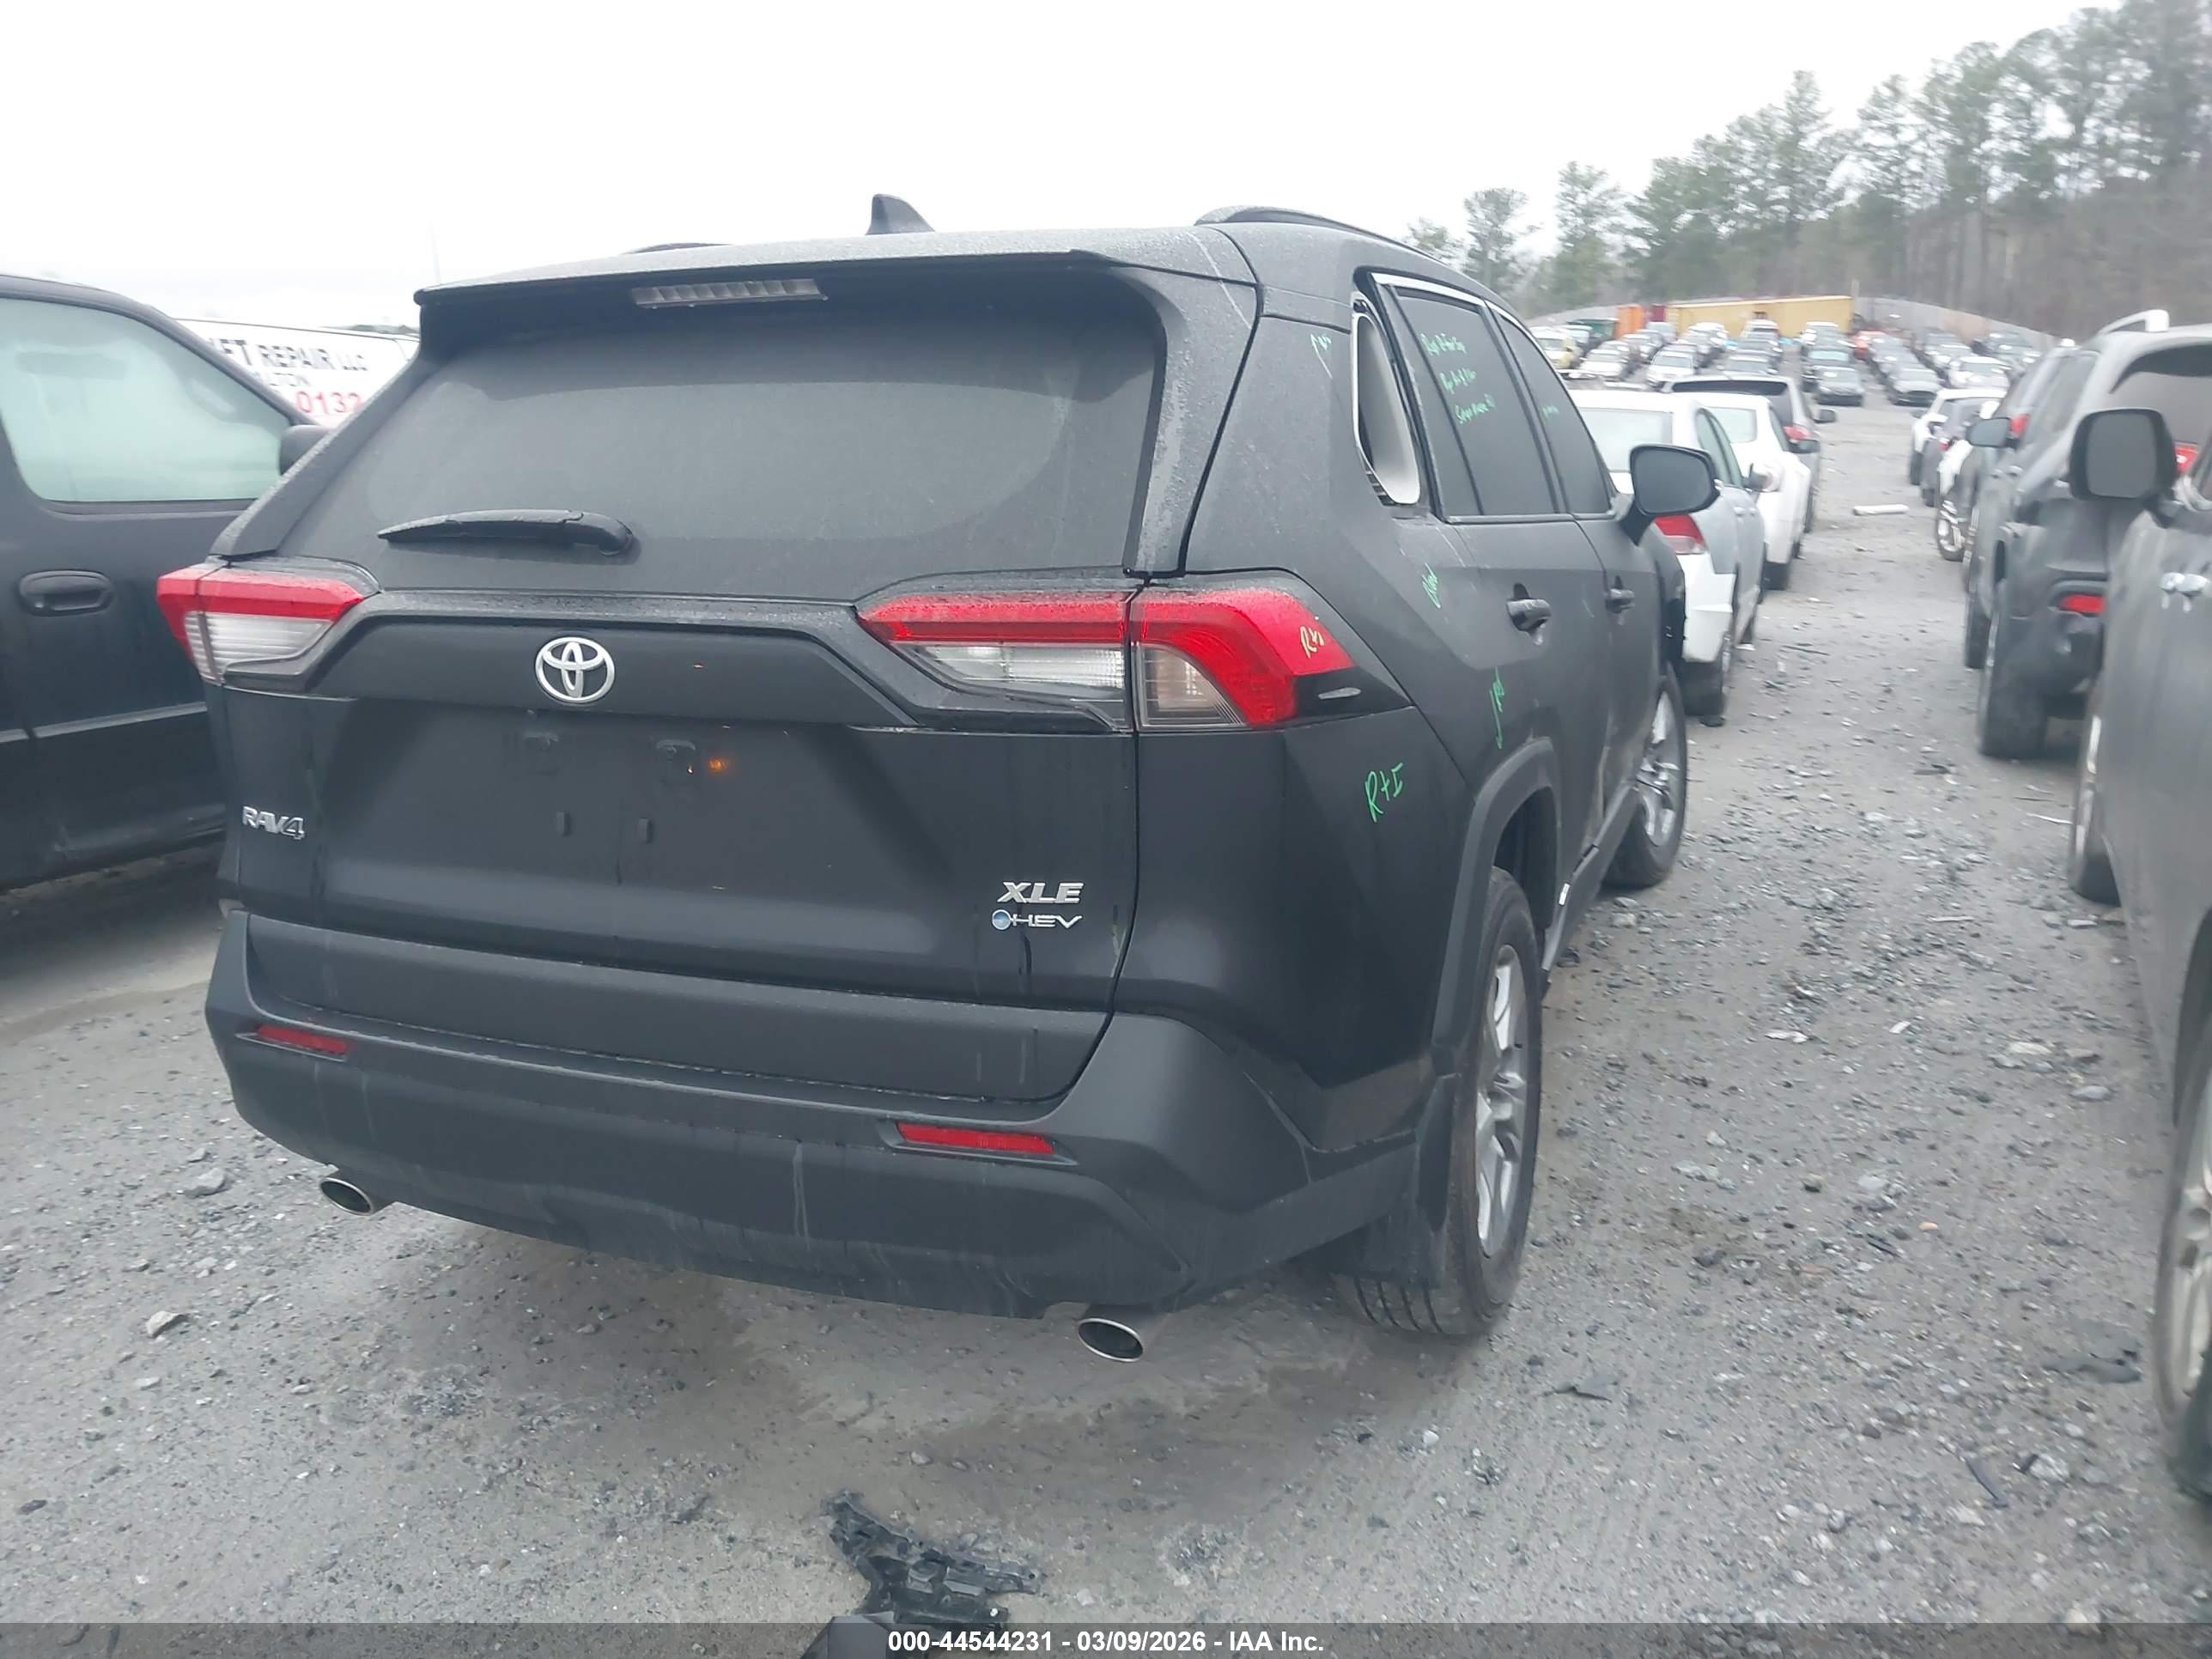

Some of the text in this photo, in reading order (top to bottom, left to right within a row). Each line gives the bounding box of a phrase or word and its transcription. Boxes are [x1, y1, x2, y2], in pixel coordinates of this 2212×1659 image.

[257, 344, 336, 370] REPAIR
[337, 350, 369, 371] LLC
[241, 805, 306, 841] RAV4
[997, 881, 1085, 903] XLE
[1011, 914, 1083, 929] HEV
